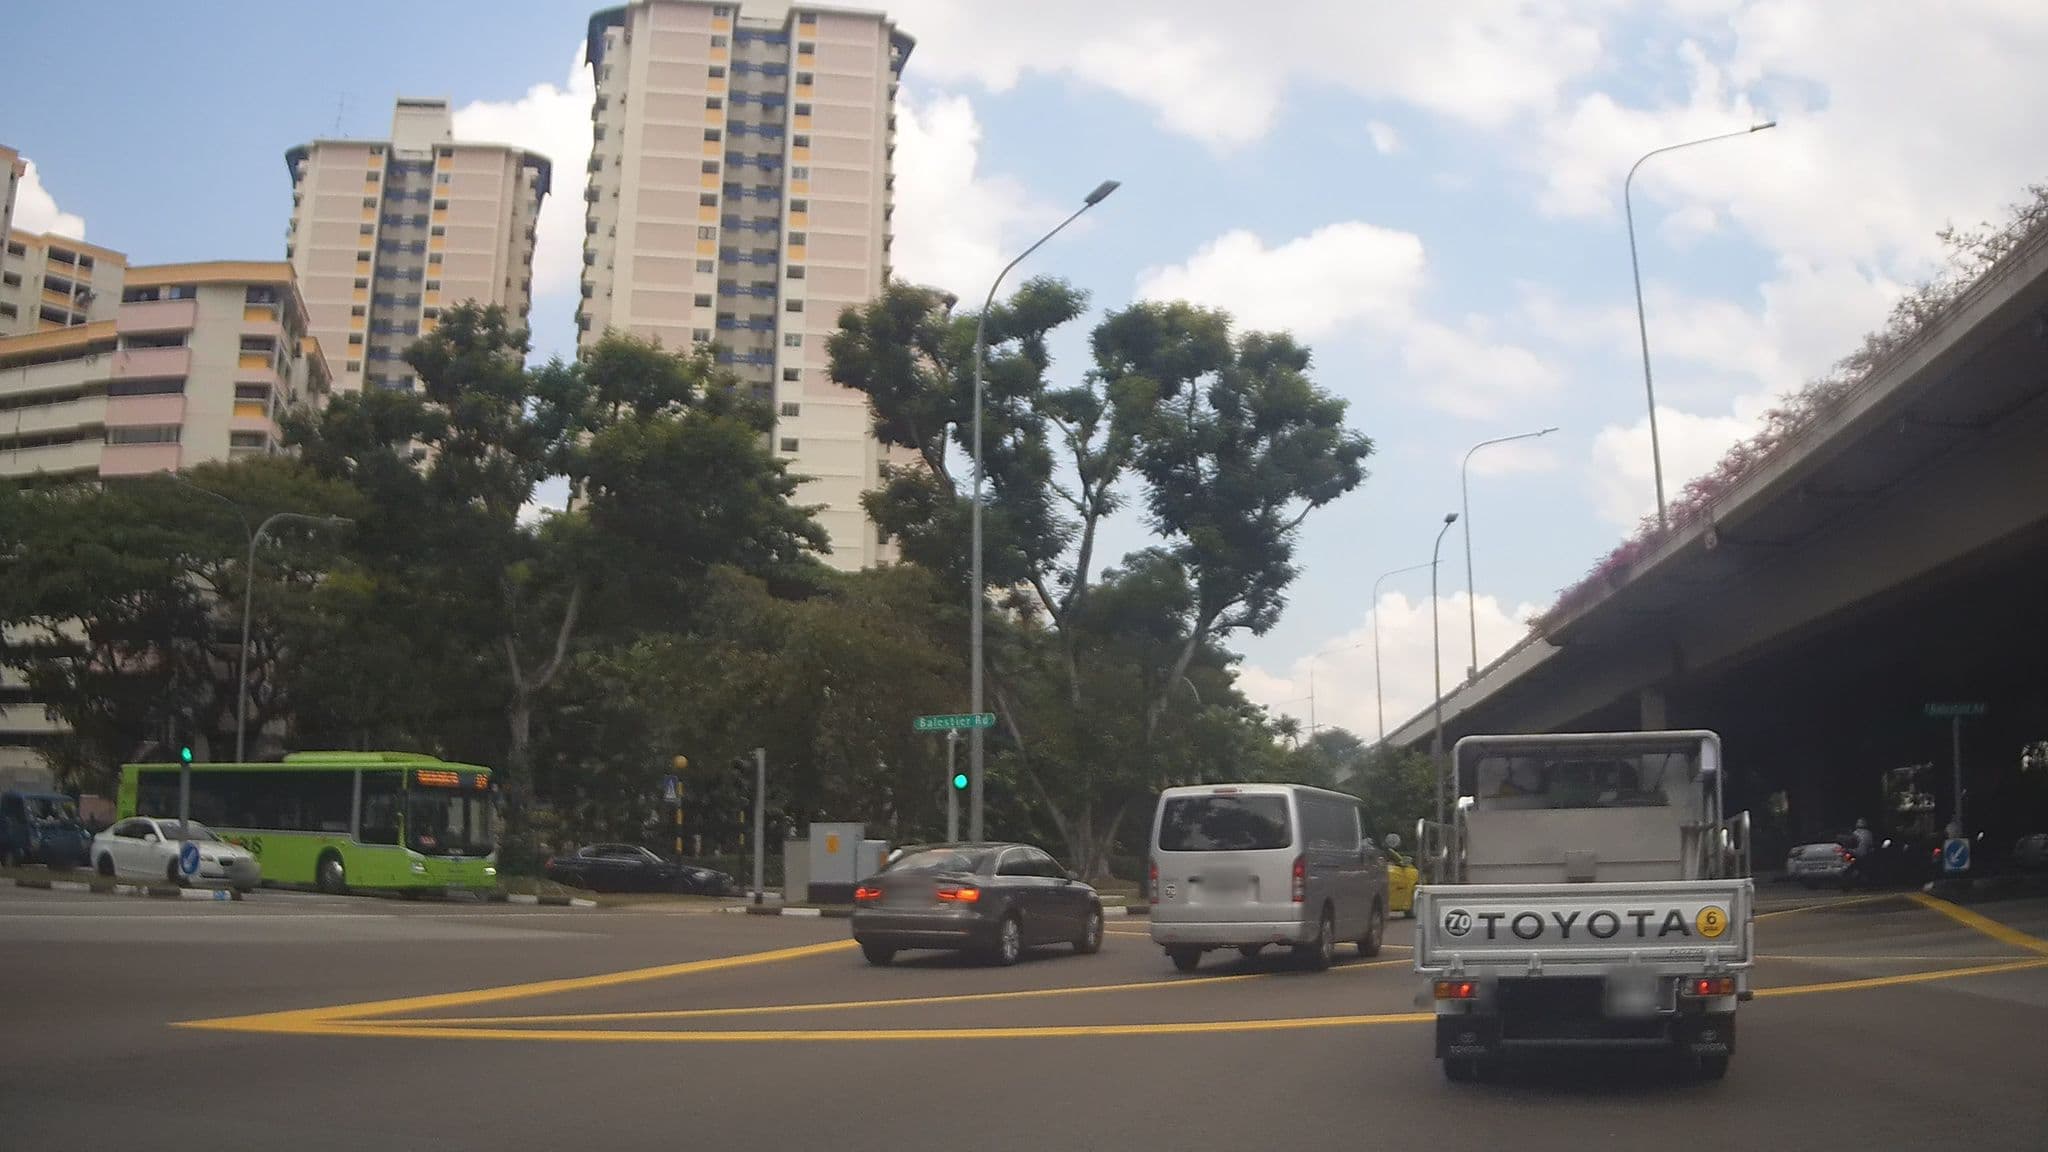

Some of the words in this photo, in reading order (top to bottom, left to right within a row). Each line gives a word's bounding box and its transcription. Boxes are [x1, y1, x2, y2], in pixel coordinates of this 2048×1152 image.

[919, 717, 971, 728] Balestier
[975, 714, 990, 725] Rd
[1477, 908, 1692, 940] TOYOTA
[1706, 911, 1717, 925] 6
